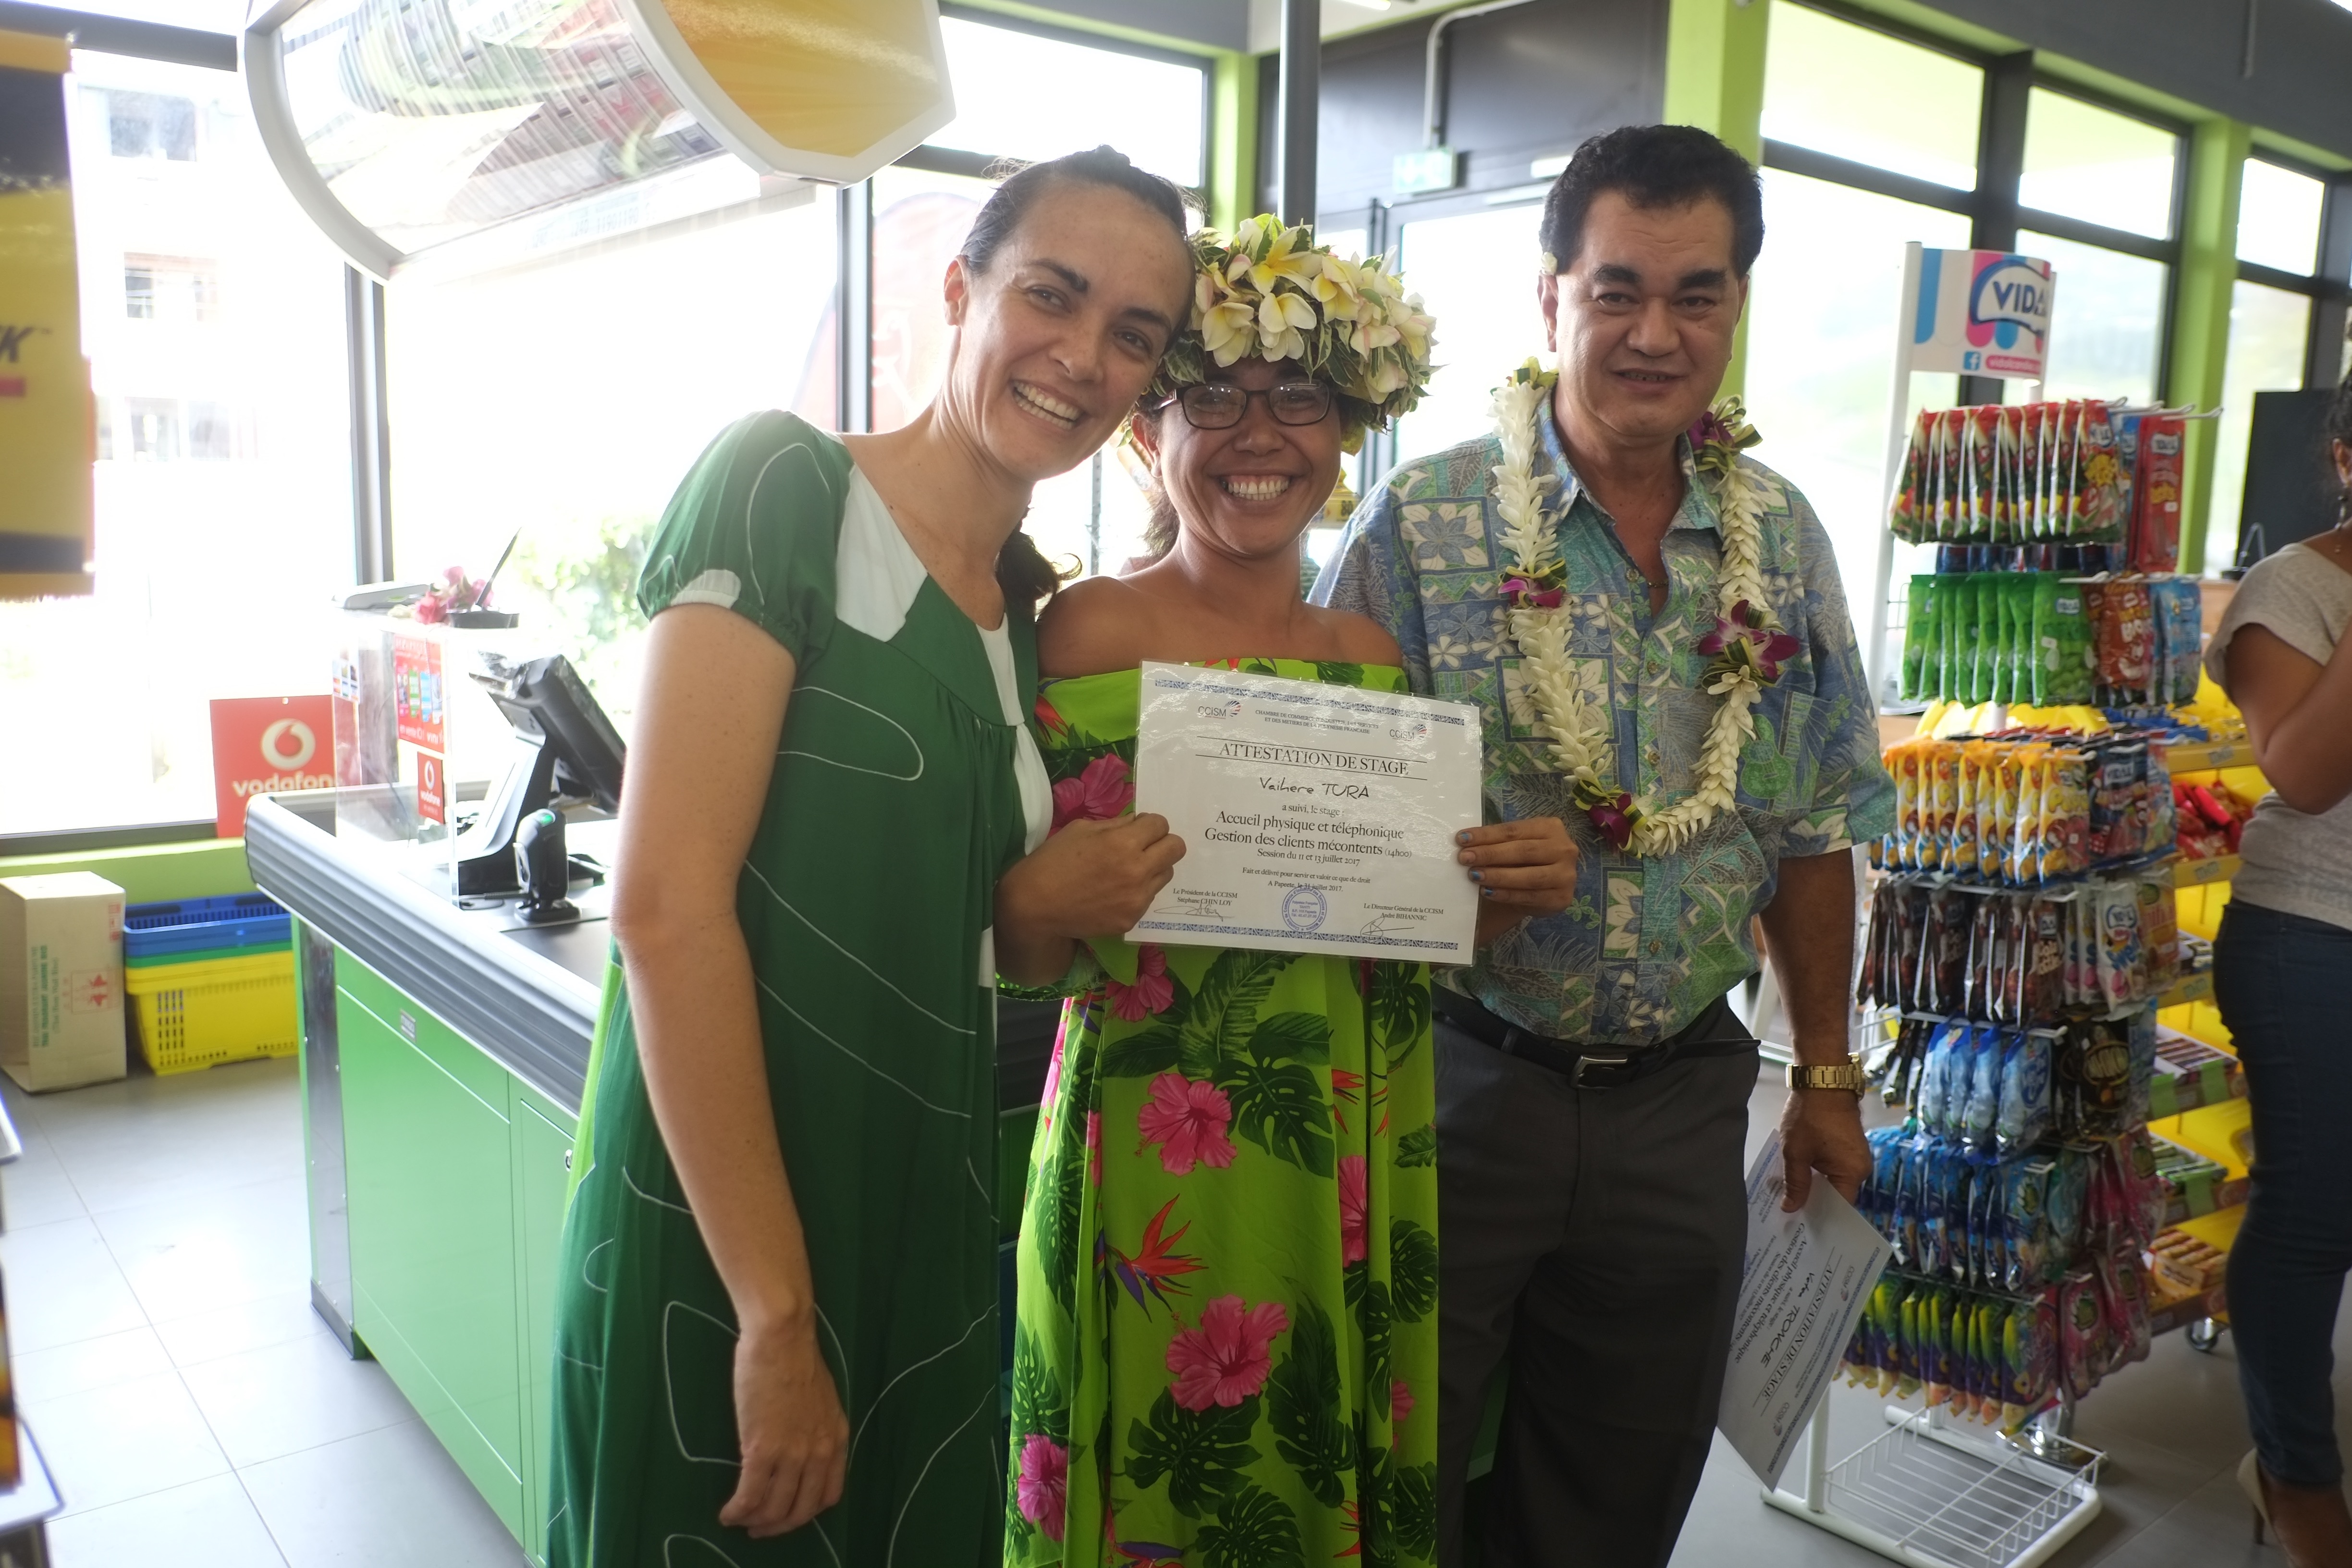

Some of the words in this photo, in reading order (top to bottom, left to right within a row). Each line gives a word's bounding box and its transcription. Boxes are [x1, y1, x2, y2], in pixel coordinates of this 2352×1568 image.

[1994, 282, 2046, 317] VIDA
[1219, 743, 1332, 766] ATTESTATION
[1335, 755, 1357, 769] DE
[1360, 758, 1409, 776] STAGE
[232, 770, 339, 797] vodafon
[1260, 777, 1314, 794] Vaihere
[1322, 784, 1369, 799] TURA
[1215, 810, 1261, 826] Accueil
[1262, 815, 1315, 833] physique
[1318, 822, 1329, 832] et
[1332, 822, 1404, 841] téléphonique
[1288, 804, 1309, 814] suivi,
[1311, 805, 1318, 814] le
[1319, 808, 1340, 818] stage
[1205, 827, 1252, 844] Gestion
[1255, 833, 1275, 845] des
[1277, 835, 1315, 849] clients
[1318, 839, 1383, 855] mécontents
[1384, 848, 1412, 858] (14h00)
[1257, 848, 1285, 858] Session
[1286, 851, 1296, 859] du
[1314, 855, 1321, 864] 13
[1321, 854, 1343, 864] juillet
[1345, 858, 1360, 867] 2017
[1786, 1223, 1804, 1255] Gestion
[1791, 1237, 1807, 1269] Accueil
[1777, 1255, 1788, 1270] des
[1763, 1270, 1779, 1296] clients
[1771, 1267, 1792, 1303] physique
[1735, 1297, 1763, 1341] mécontents
[1765, 1304, 1772, 1313] et
[1795, 1264, 1832, 1346] ATTESTATION
[1735, 1313, 1766, 1363] téléphonique
[1761, 1306, 1800, 1367] TRONCHE
[1785, 1346, 1797, 1364] DE
[1763, 1362, 1787, 1400] STAGE
